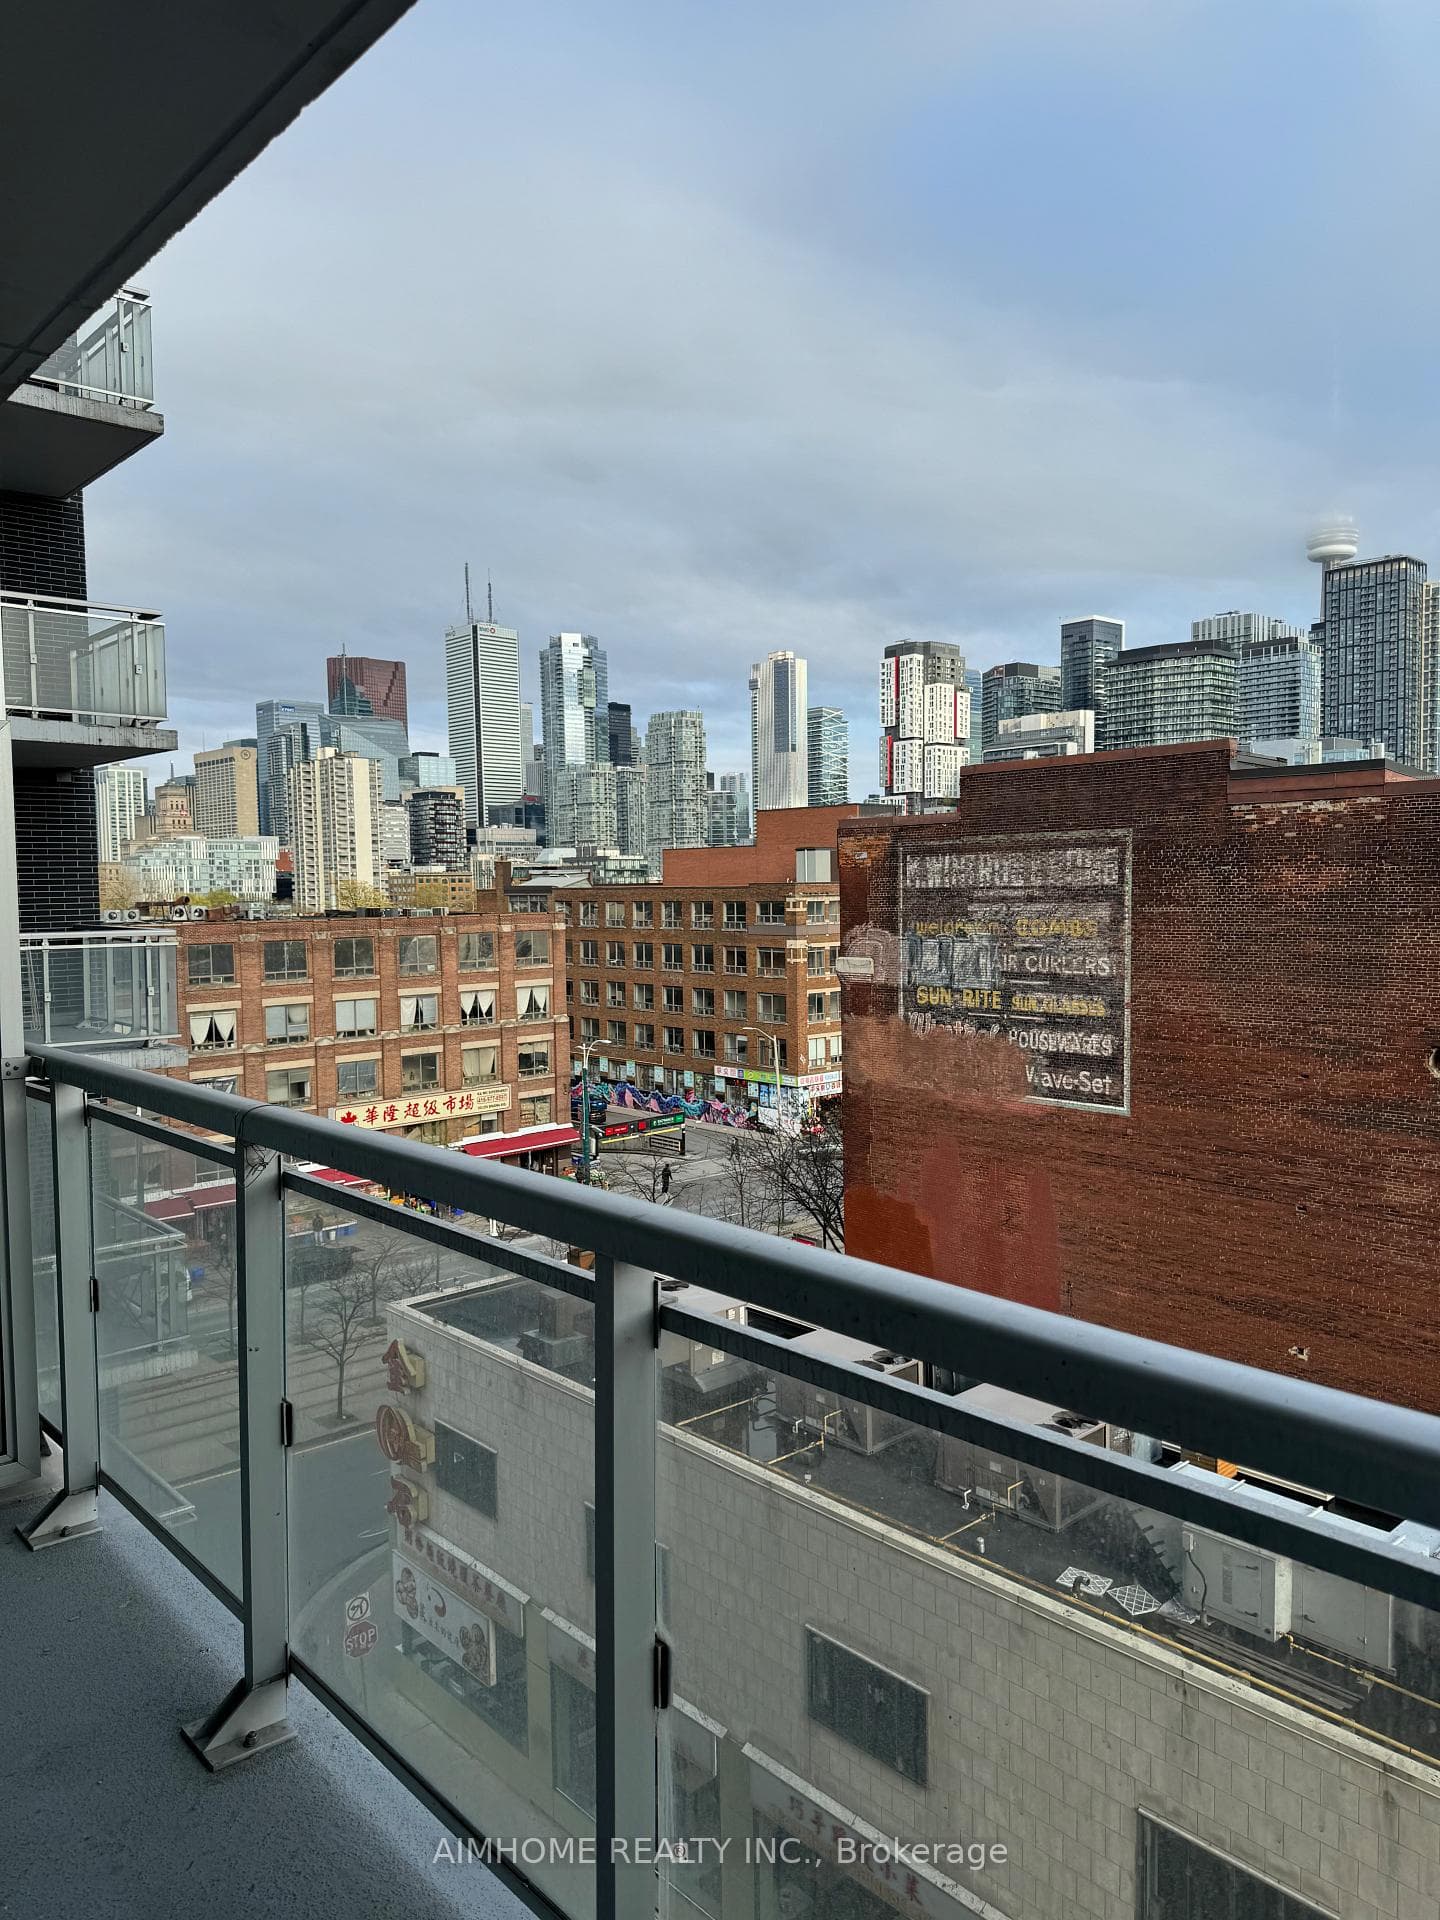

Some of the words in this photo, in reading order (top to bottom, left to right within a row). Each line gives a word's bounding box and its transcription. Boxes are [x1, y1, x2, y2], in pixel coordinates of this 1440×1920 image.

[1025, 954, 1112, 976] CURLERS
[916, 985, 952, 1006] SUN
[963, 988, 1002, 1009] RITE
[346, 1628, 376, 1651] STOP
